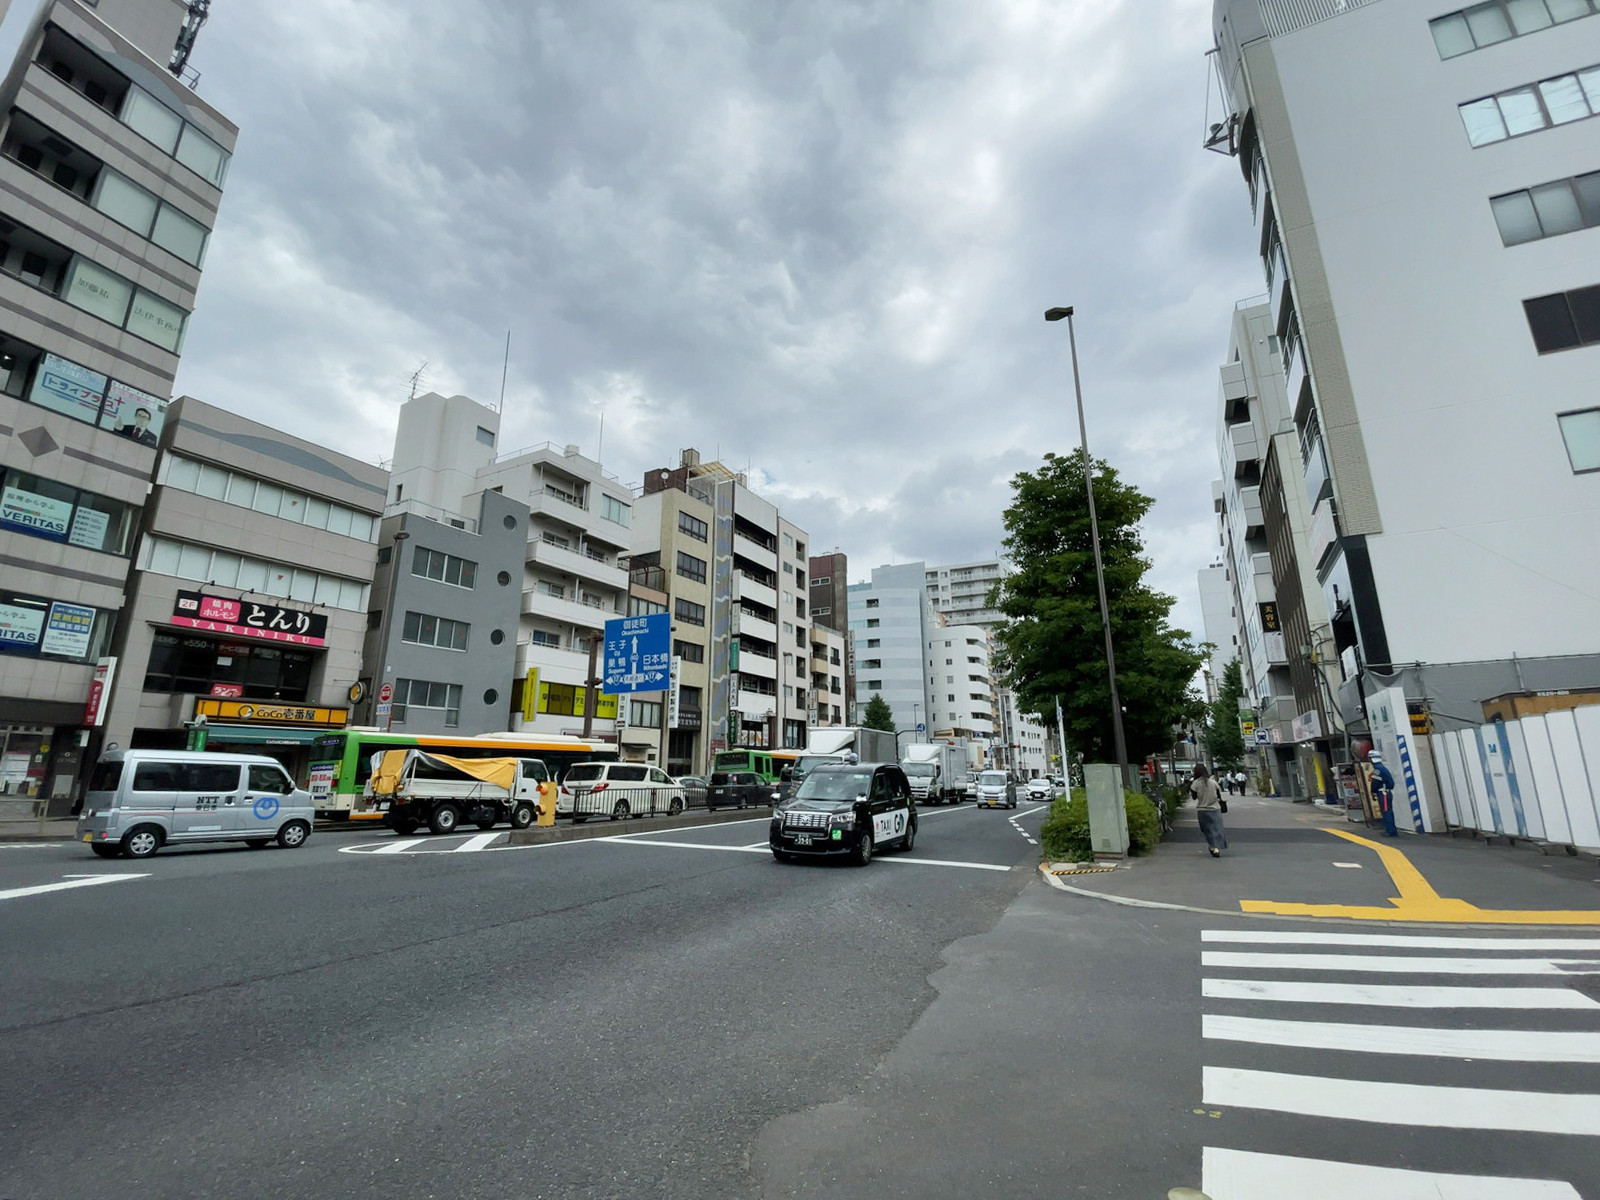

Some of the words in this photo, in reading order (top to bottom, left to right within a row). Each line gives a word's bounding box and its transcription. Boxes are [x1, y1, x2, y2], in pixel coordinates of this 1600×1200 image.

[2, 509, 65, 532] VERITAS
[182, 600, 196, 608] 2F
[212, 599, 232, 610] 焼肉
[202, 608, 236, 621] ホルモン
[247, 604, 310, 634] とんり
[623, 618, 648, 630] 御徒町
[191, 618, 310, 644] YAKINIKU
[608, 640, 627, 651] 王子
[607, 657, 626, 668] 巣鴨
[642, 652, 669, 665] 日本橋
[257, 707, 316, 721] CoCo壱番屋
[196, 796, 220, 804] NTT
